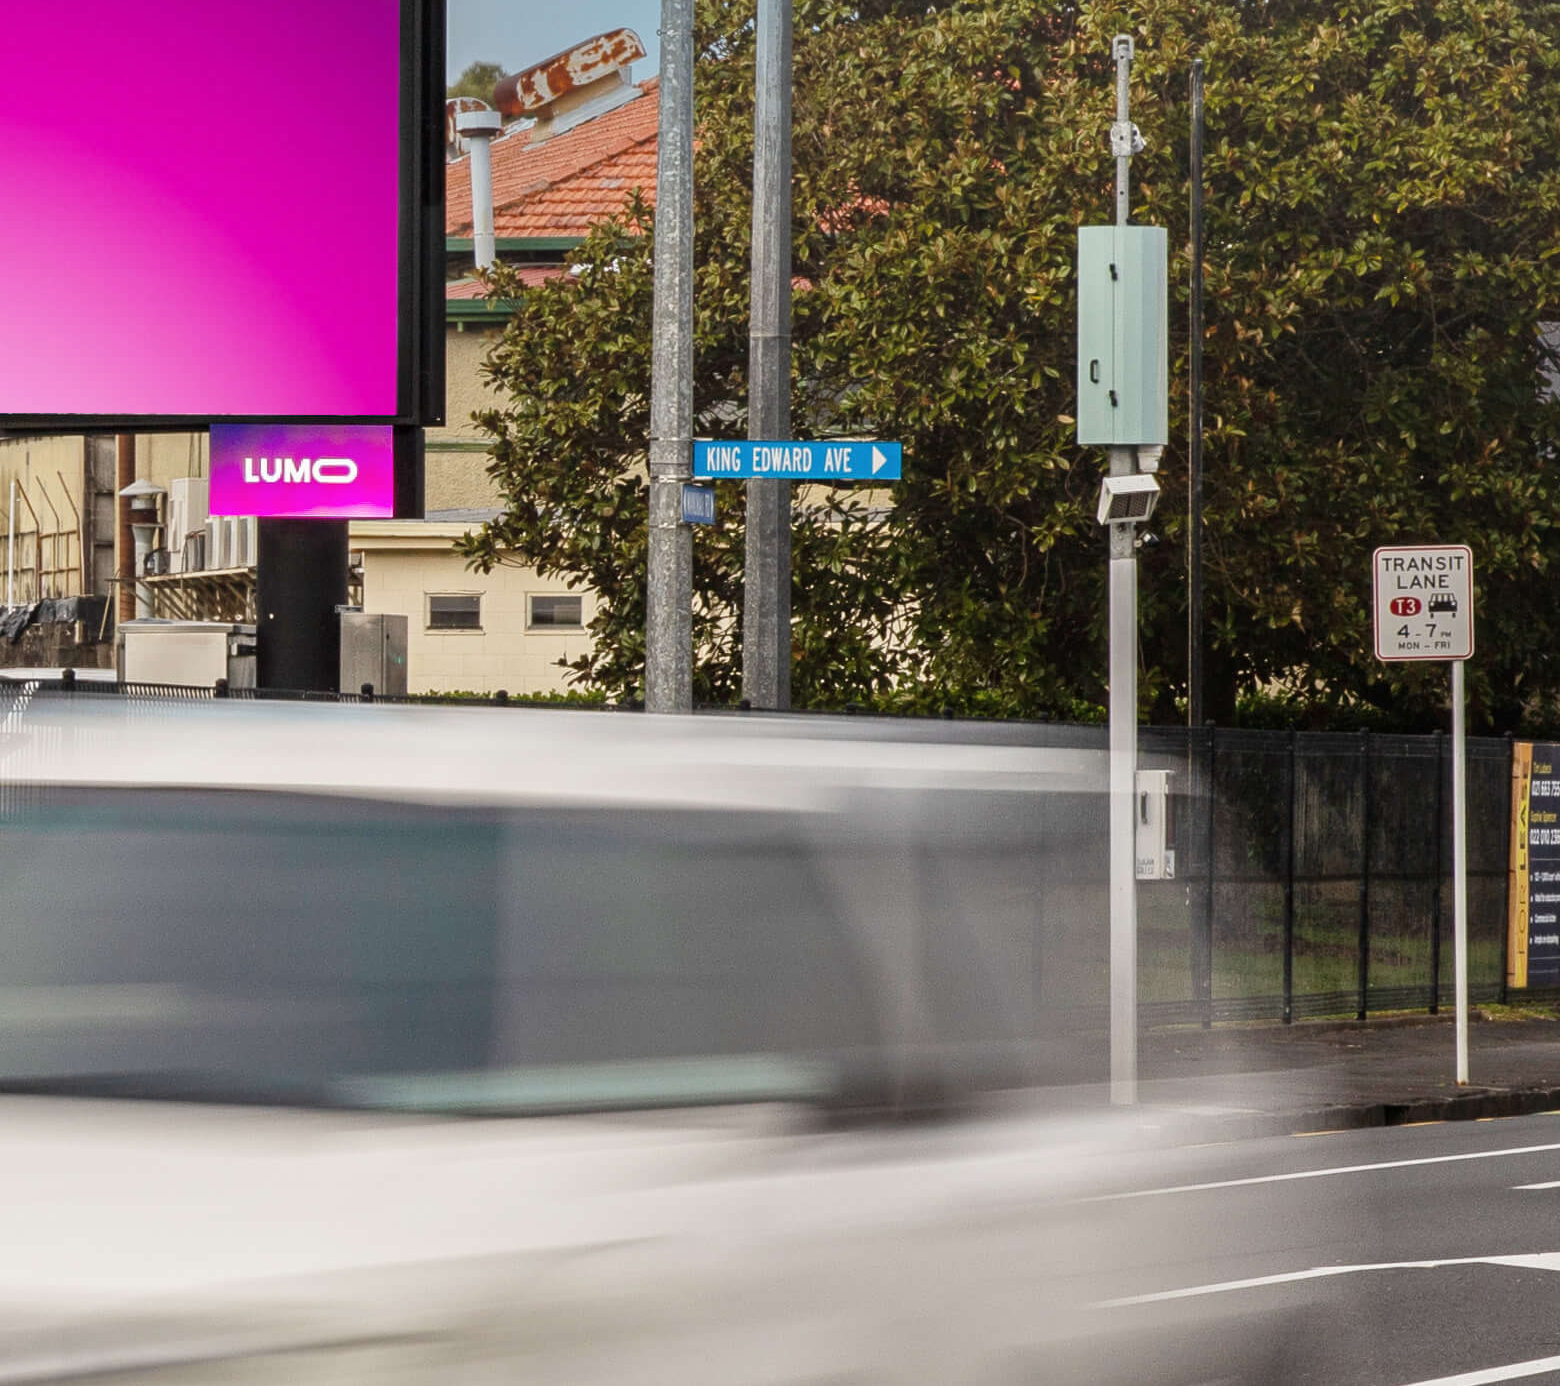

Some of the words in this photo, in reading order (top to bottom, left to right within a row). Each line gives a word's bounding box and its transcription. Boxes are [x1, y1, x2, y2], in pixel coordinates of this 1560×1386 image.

[706, 447, 741, 472] KING
[752, 447, 812, 472] EDWARD
[824, 448, 852, 472] AVE
[244, 457, 357, 483] LUMO
[1382, 556, 1464, 571] TRANSIT
[1397, 574, 1449, 589] LANE
[1396, 599, 1416, 614] T3
[1397, 624, 1410, 638] 4
[1425, 623, 1437, 638] 7
[1434, 641, 1451, 649] FRI
